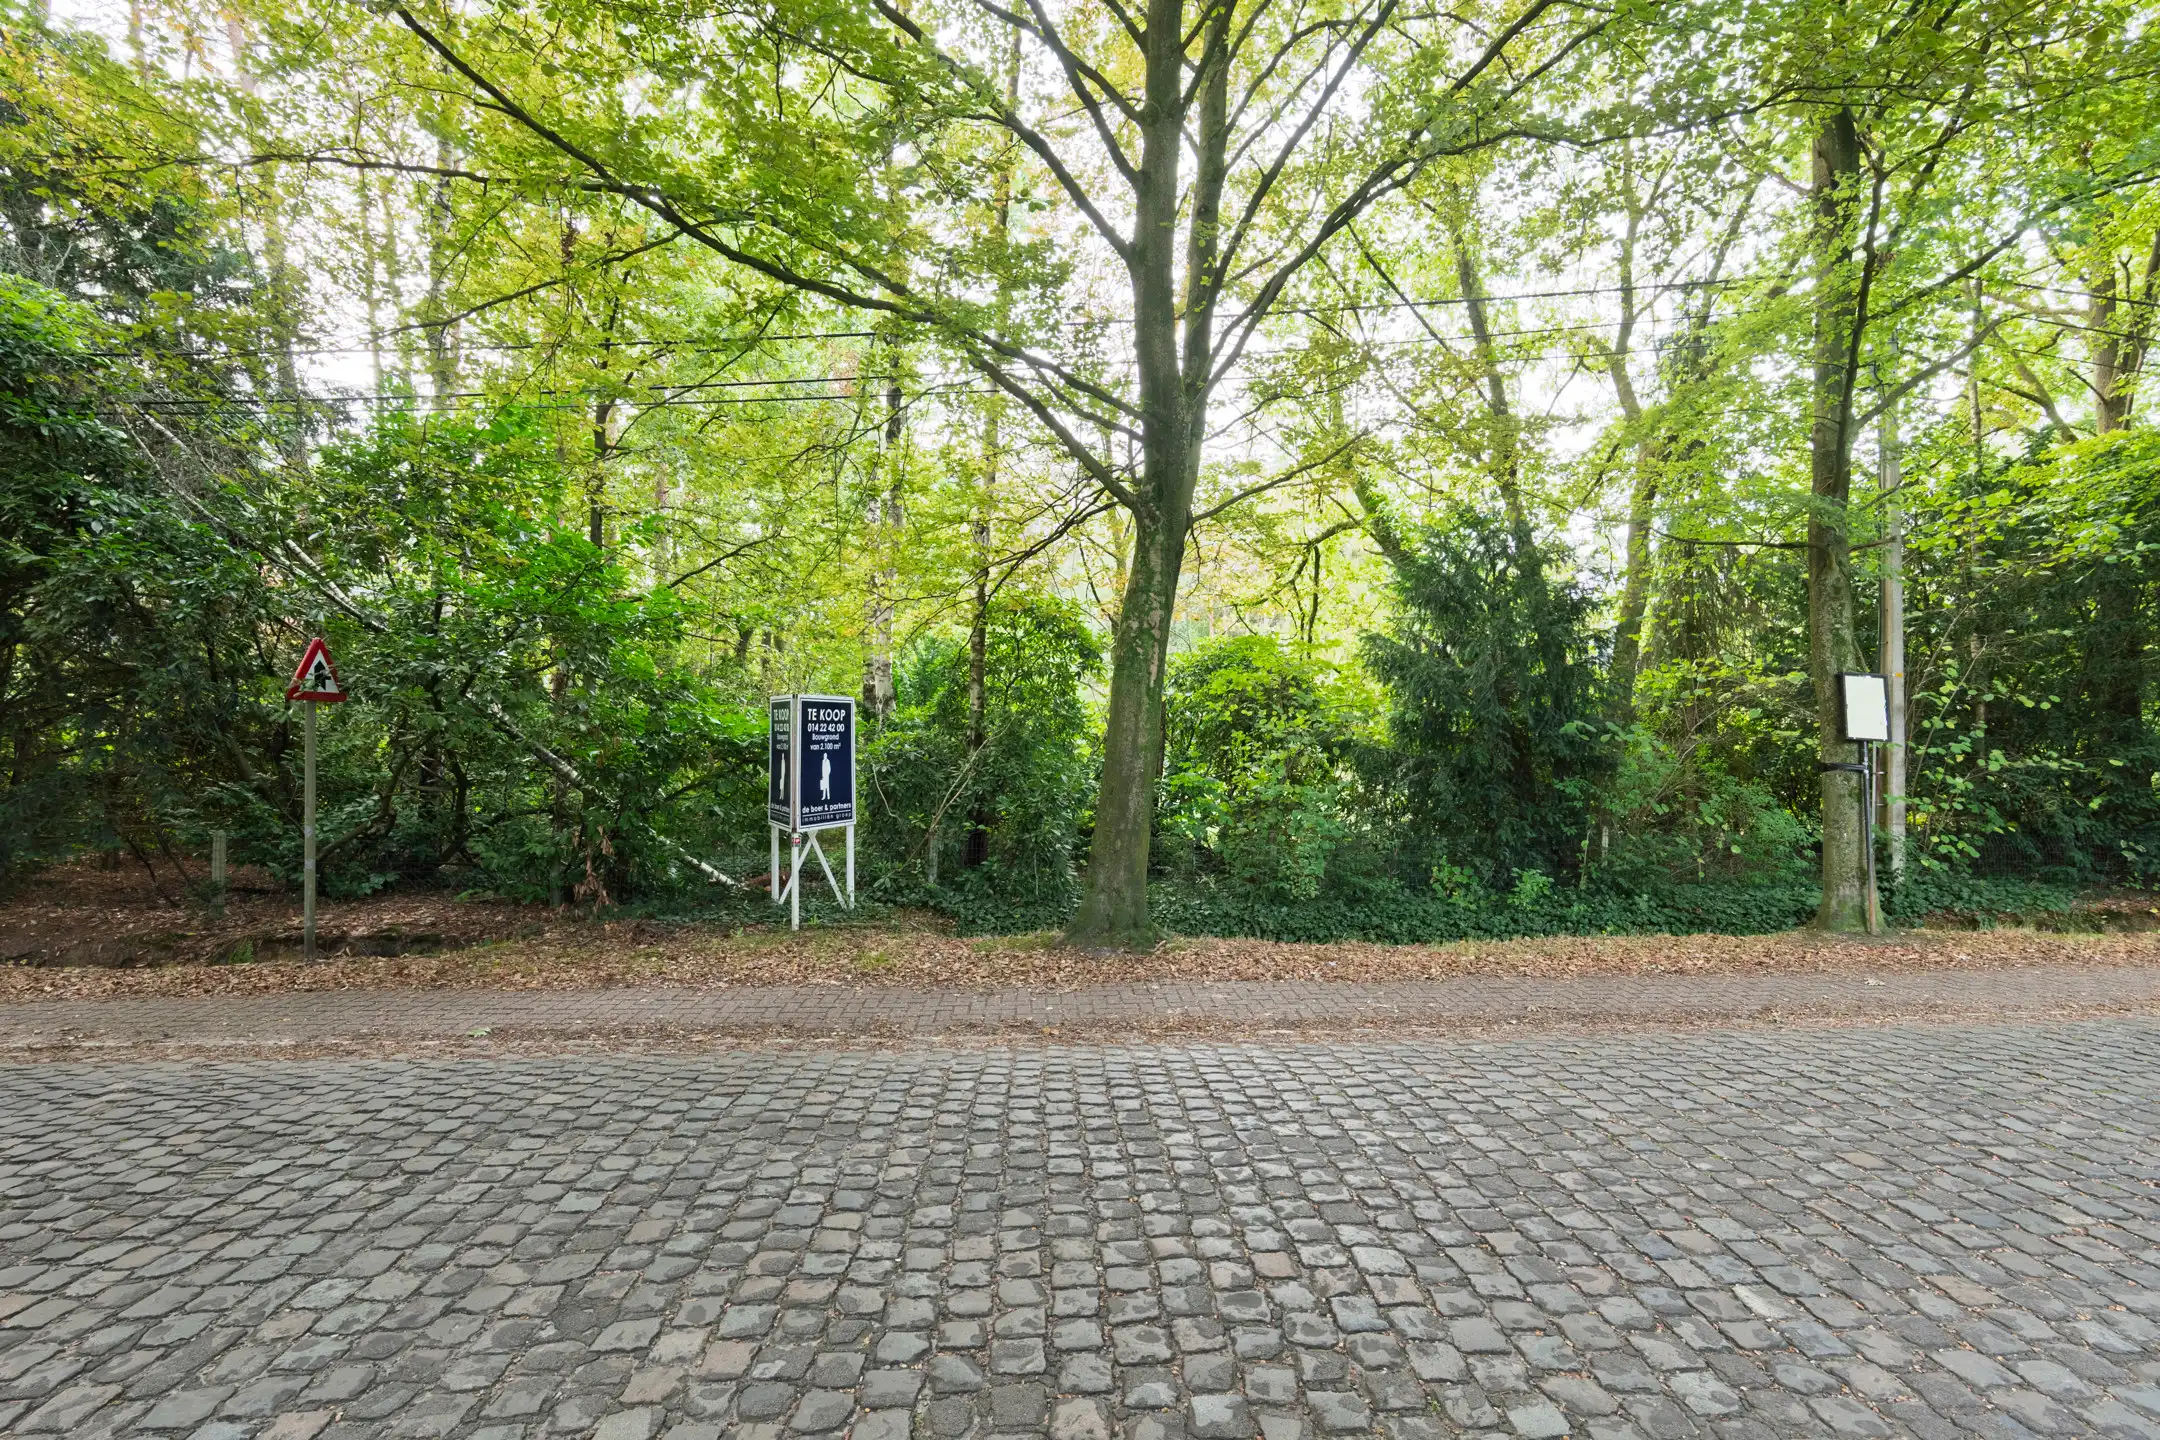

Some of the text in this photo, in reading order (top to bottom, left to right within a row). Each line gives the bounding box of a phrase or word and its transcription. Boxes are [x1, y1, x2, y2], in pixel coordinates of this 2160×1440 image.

[808, 708, 846, 721] TE KOOP
[808, 723, 819, 731] 014
[820, 723, 827, 731] 22
[812, 733, 839, 741] Bouwgrond
[830, 803, 851, 811] partners
